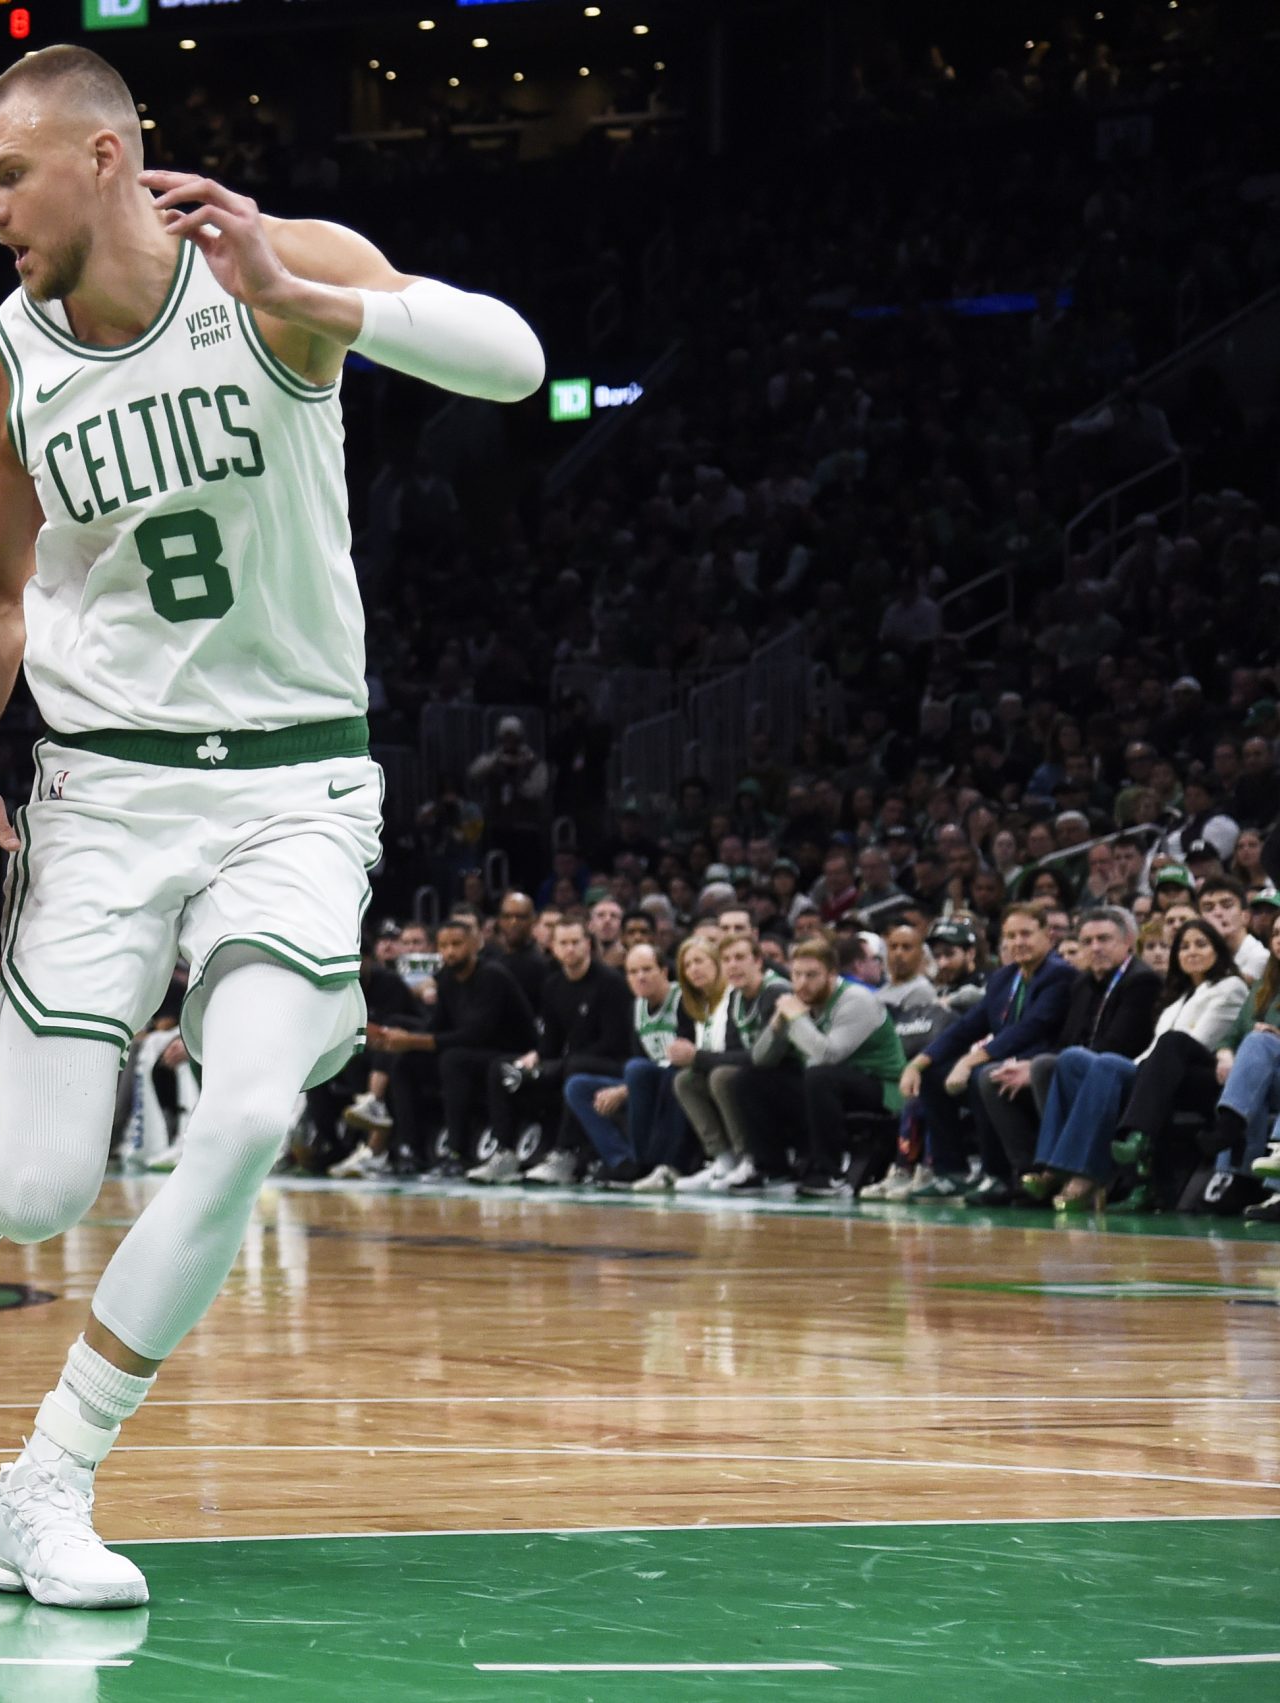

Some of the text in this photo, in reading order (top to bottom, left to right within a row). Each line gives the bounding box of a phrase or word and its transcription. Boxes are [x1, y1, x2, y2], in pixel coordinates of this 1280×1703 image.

[185, 304, 230, 334] VISTA
[190, 323, 232, 351] PRINT
[44, 384, 267, 525] CELTICS
[133, 508, 236, 624] 8
